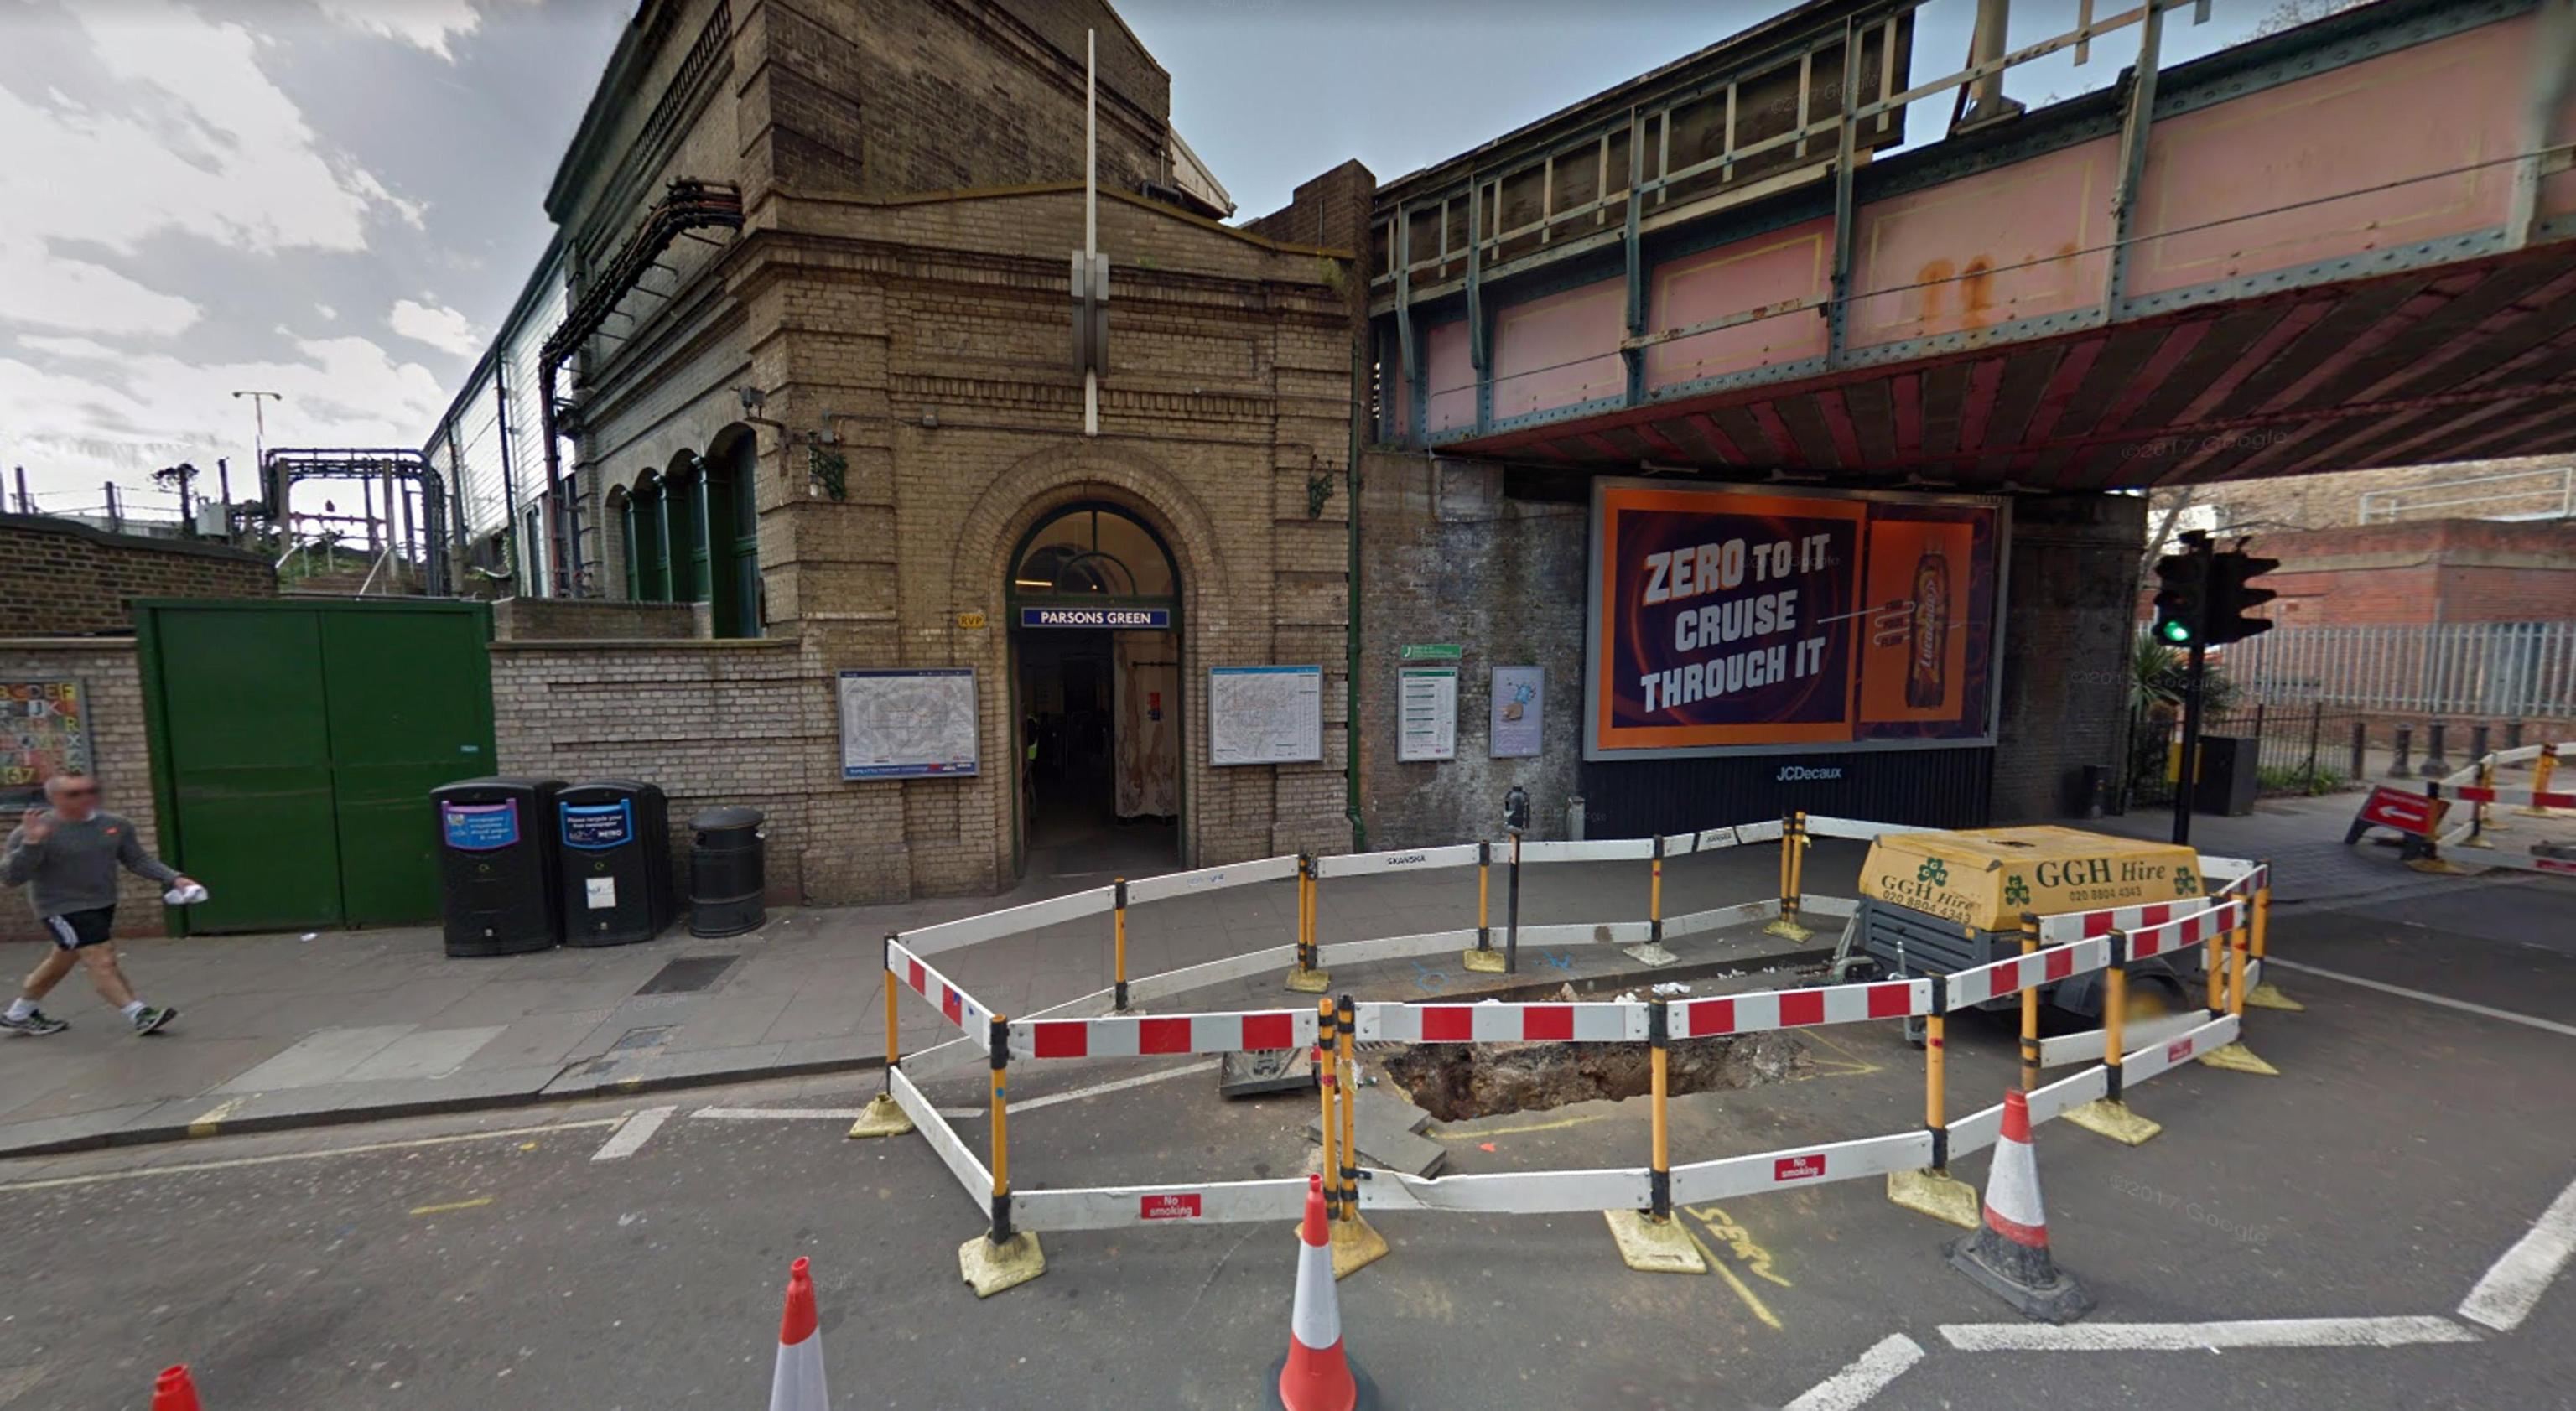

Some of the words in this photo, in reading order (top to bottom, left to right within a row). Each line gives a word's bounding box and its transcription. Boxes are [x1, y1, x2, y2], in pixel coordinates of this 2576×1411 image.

[1644, 538, 1746, 605] ZERO
[1753, 540, 1792, 582] TO
[1801, 533, 1831, 573] IT
[960, 615, 982, 625] RVP
[1041, 611, 1104, 624] PARSONS
[1107, 611, 1151, 624] GREEN
[1675, 589, 1799, 652] CRUISE
[1641, 645, 1787, 713] THROUGH
[1795, 637, 1826, 678] IT
[1776, 766, 1842, 781] JCDecaux
[1388, 855, 1426, 864] SKANSKA
[2036, 858, 2113, 888] GGH
[2121, 861, 2166, 881] Hire
[1881, 874, 1932, 900] GGH
[1937, 892, 1975, 911] Hire
[2069, 890, 2088, 901] 020
[2091, 889, 2115, 900] 8804
[2118, 886, 2142, 898] 4343
[1883, 890, 1903, 904] 020
[1907, 896, 1936, 912] 8804
[1940, 907, 1971, 924] 4343
[1794, 1157, 1806, 1168] No
[1164, 1196, 1179, 1206] No
[1150, 1206, 1193, 1218] smoking
